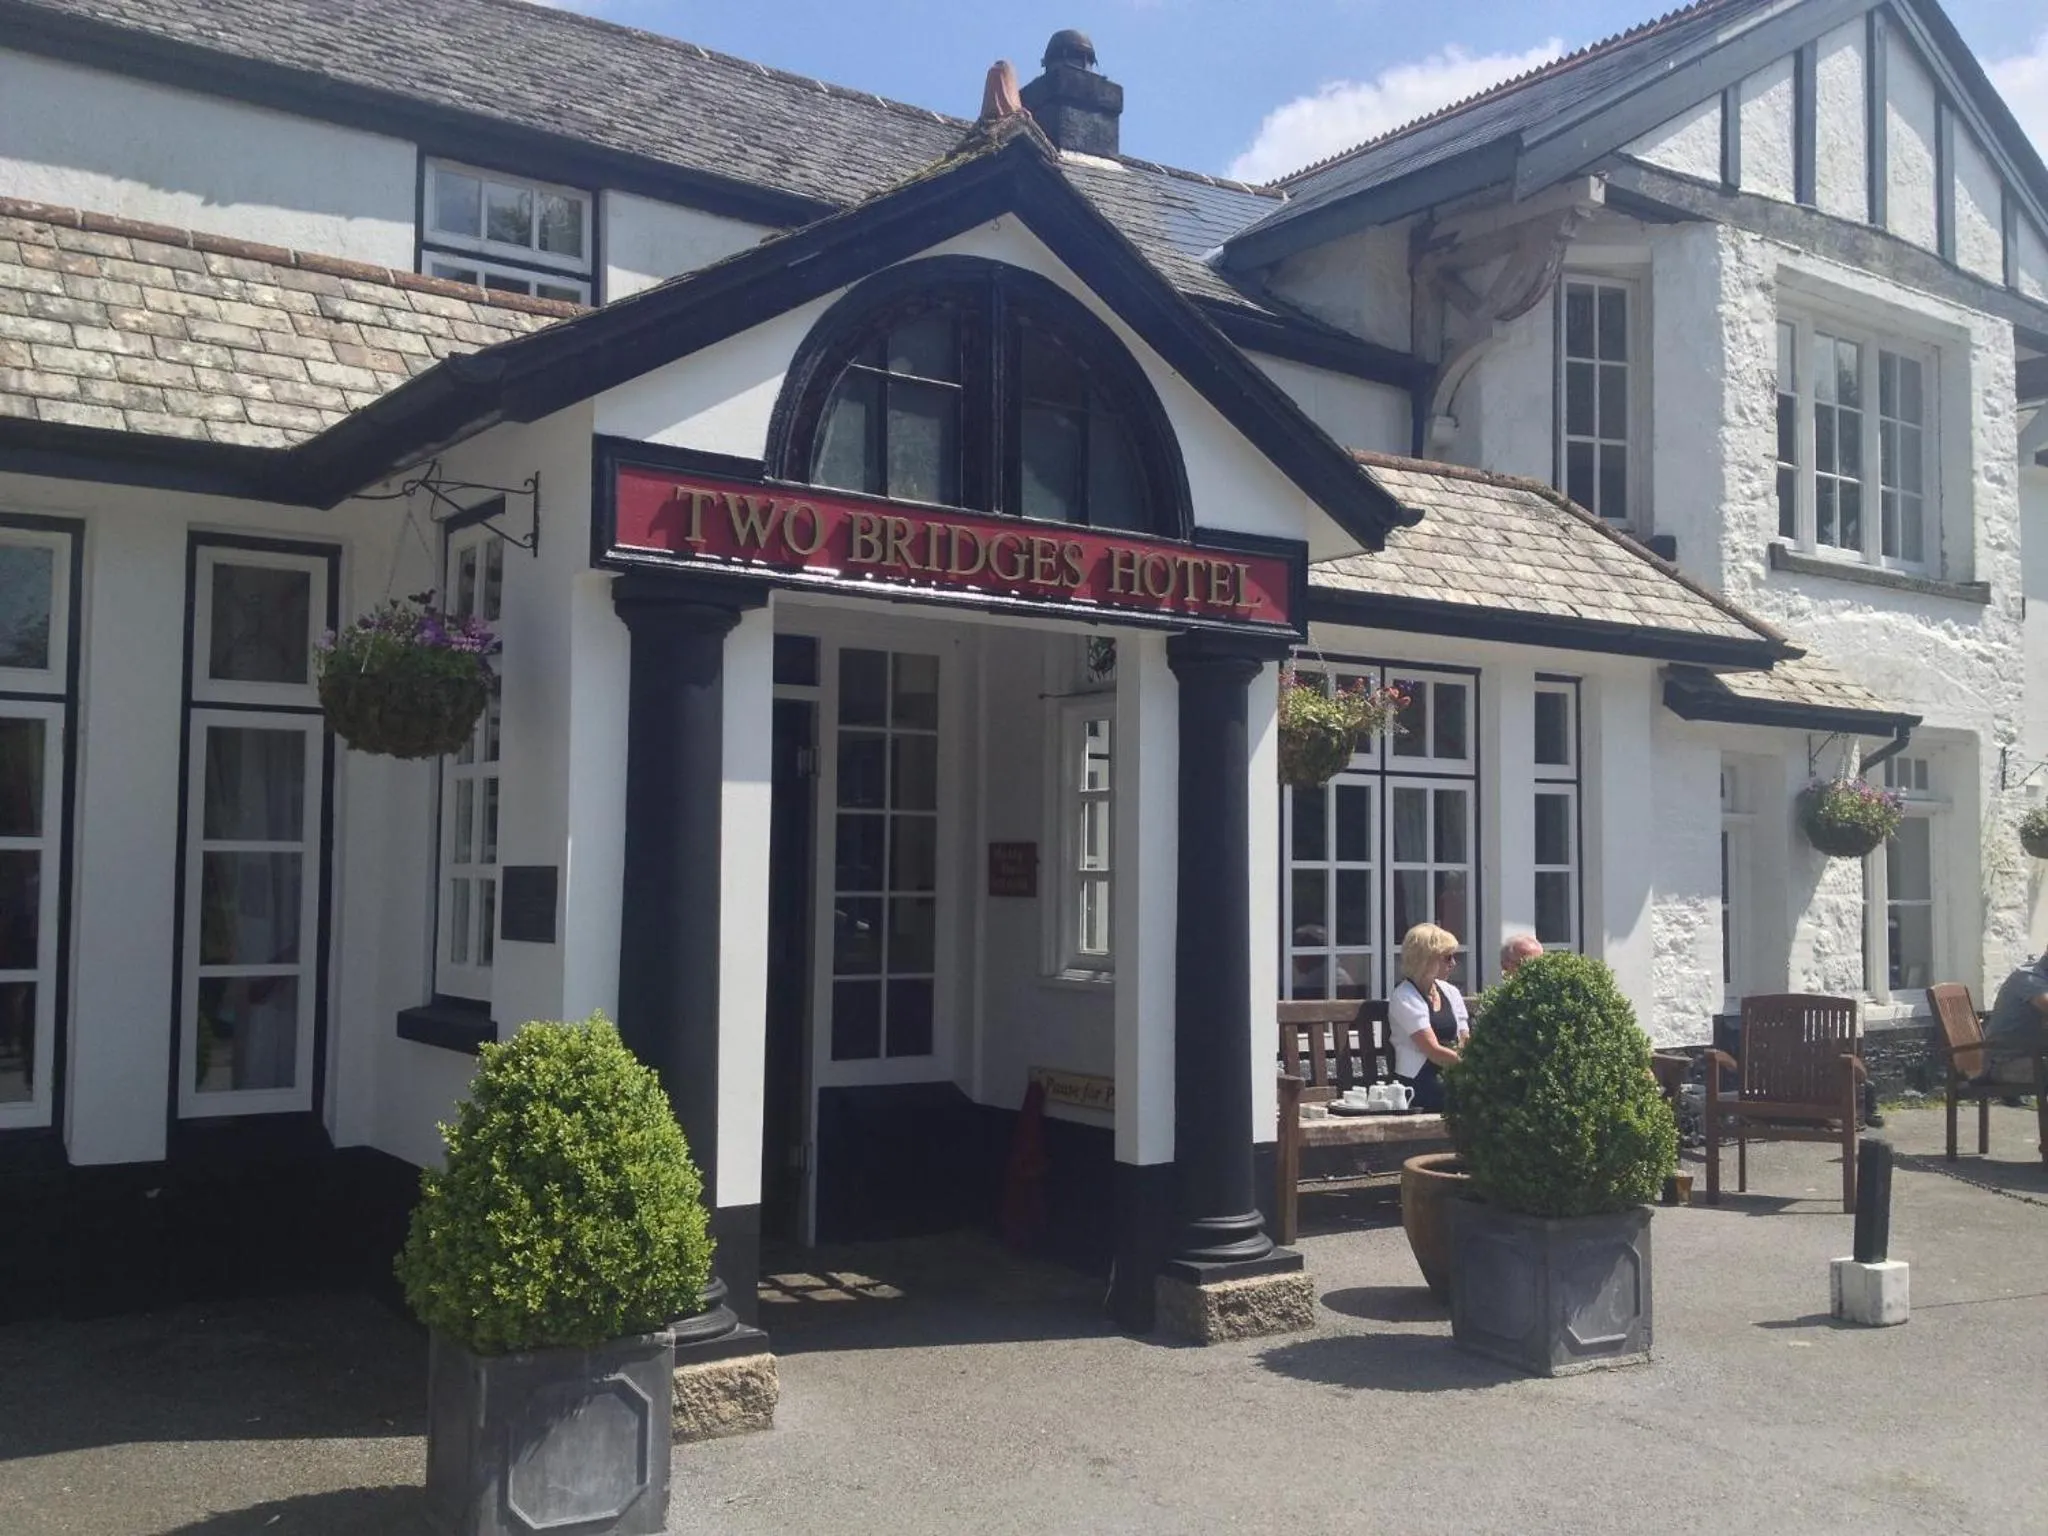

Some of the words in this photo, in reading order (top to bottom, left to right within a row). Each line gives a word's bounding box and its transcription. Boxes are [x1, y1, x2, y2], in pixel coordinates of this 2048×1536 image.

[676, 484, 827, 556] TWO
[844, 511, 1085, 588] BRIDGES
[1107, 545, 1264, 608] HOTEL
